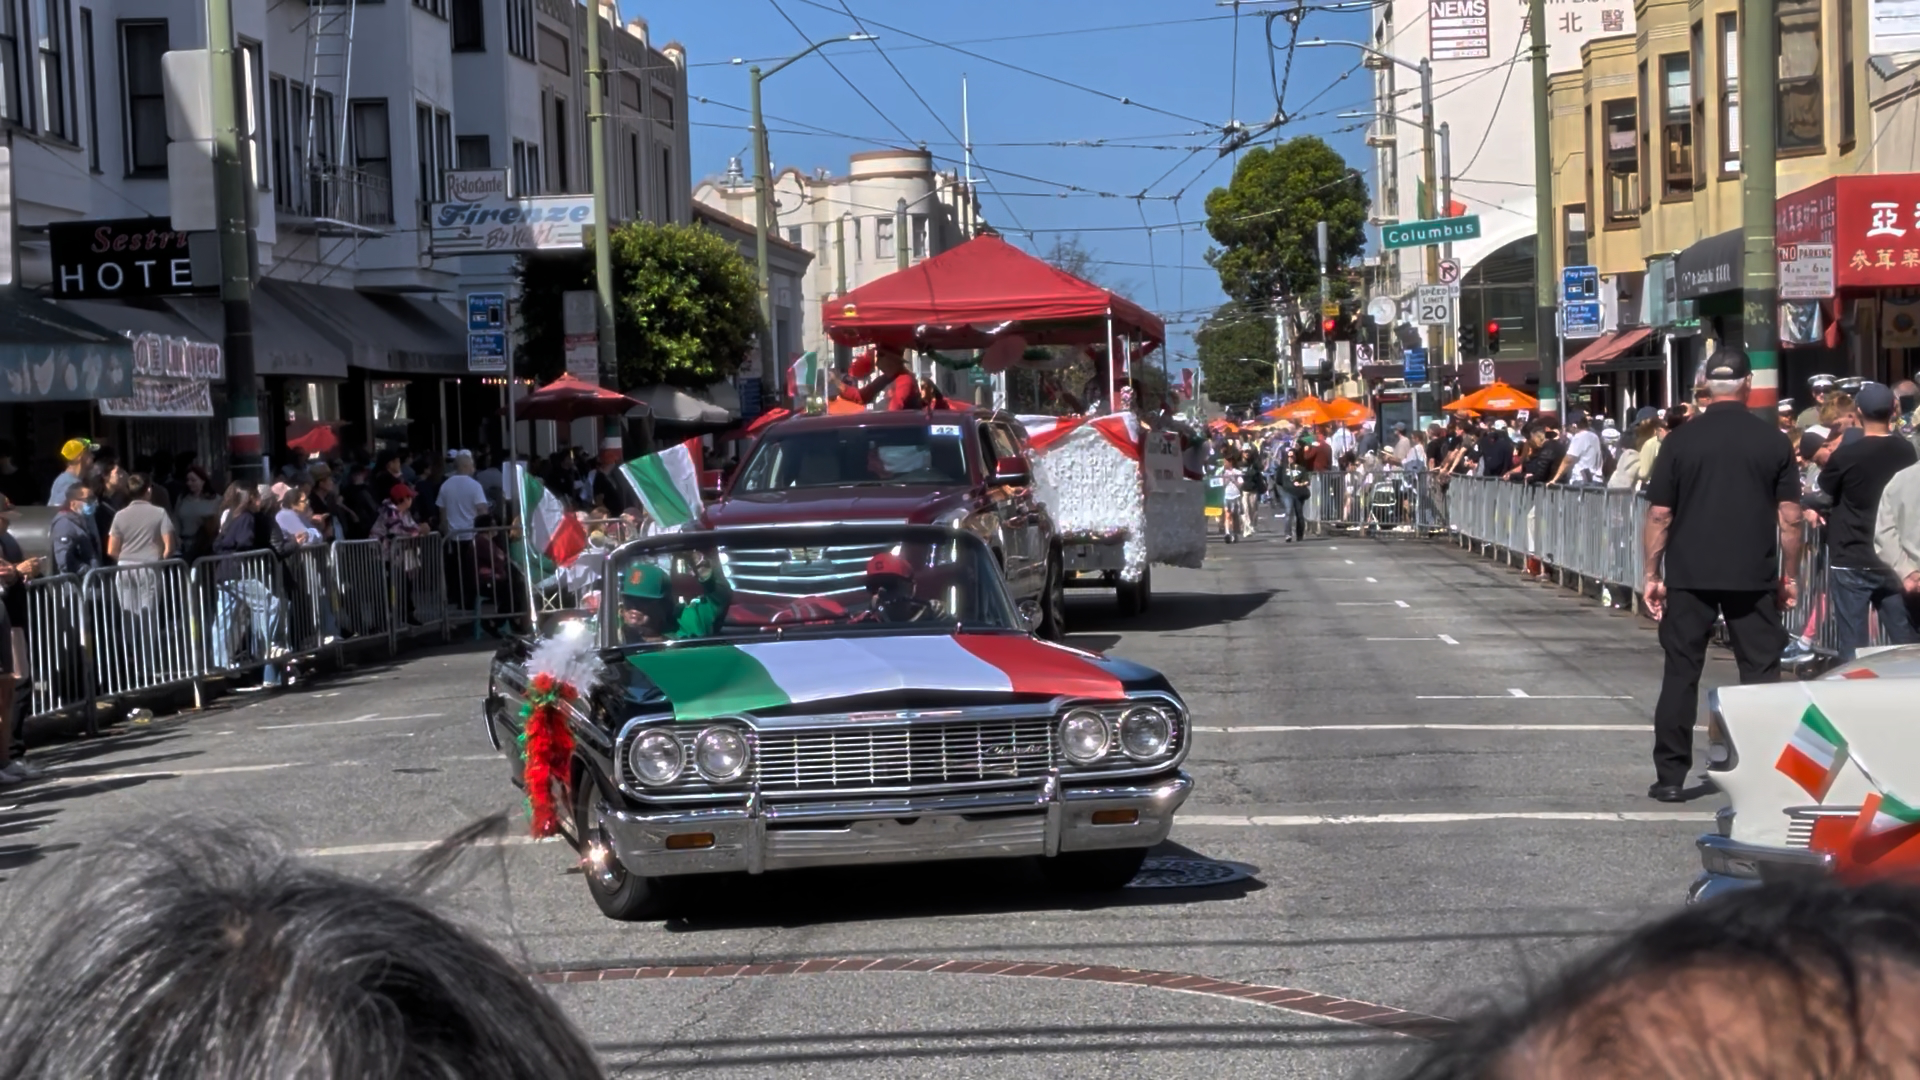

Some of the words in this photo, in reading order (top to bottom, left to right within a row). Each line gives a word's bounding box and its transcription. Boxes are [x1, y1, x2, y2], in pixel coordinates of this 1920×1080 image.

[1431, 1, 1486, 17] NEMS
[447, 173, 503, 202] Ristorante
[438, 203, 590, 226] Firenze
[1866, 202, 1920, 237] 亞
[1388, 224, 1474, 243] Columbus
[1782, 246, 1797, 260] NO
[1799, 248, 1832, 260] PARKING
[60, 258, 193, 292] HOTE
[1420, 287, 1448, 296] SPEED
[1423, 296, 1444, 304] LIMIT
[1422, 305, 1447, 320] 20
